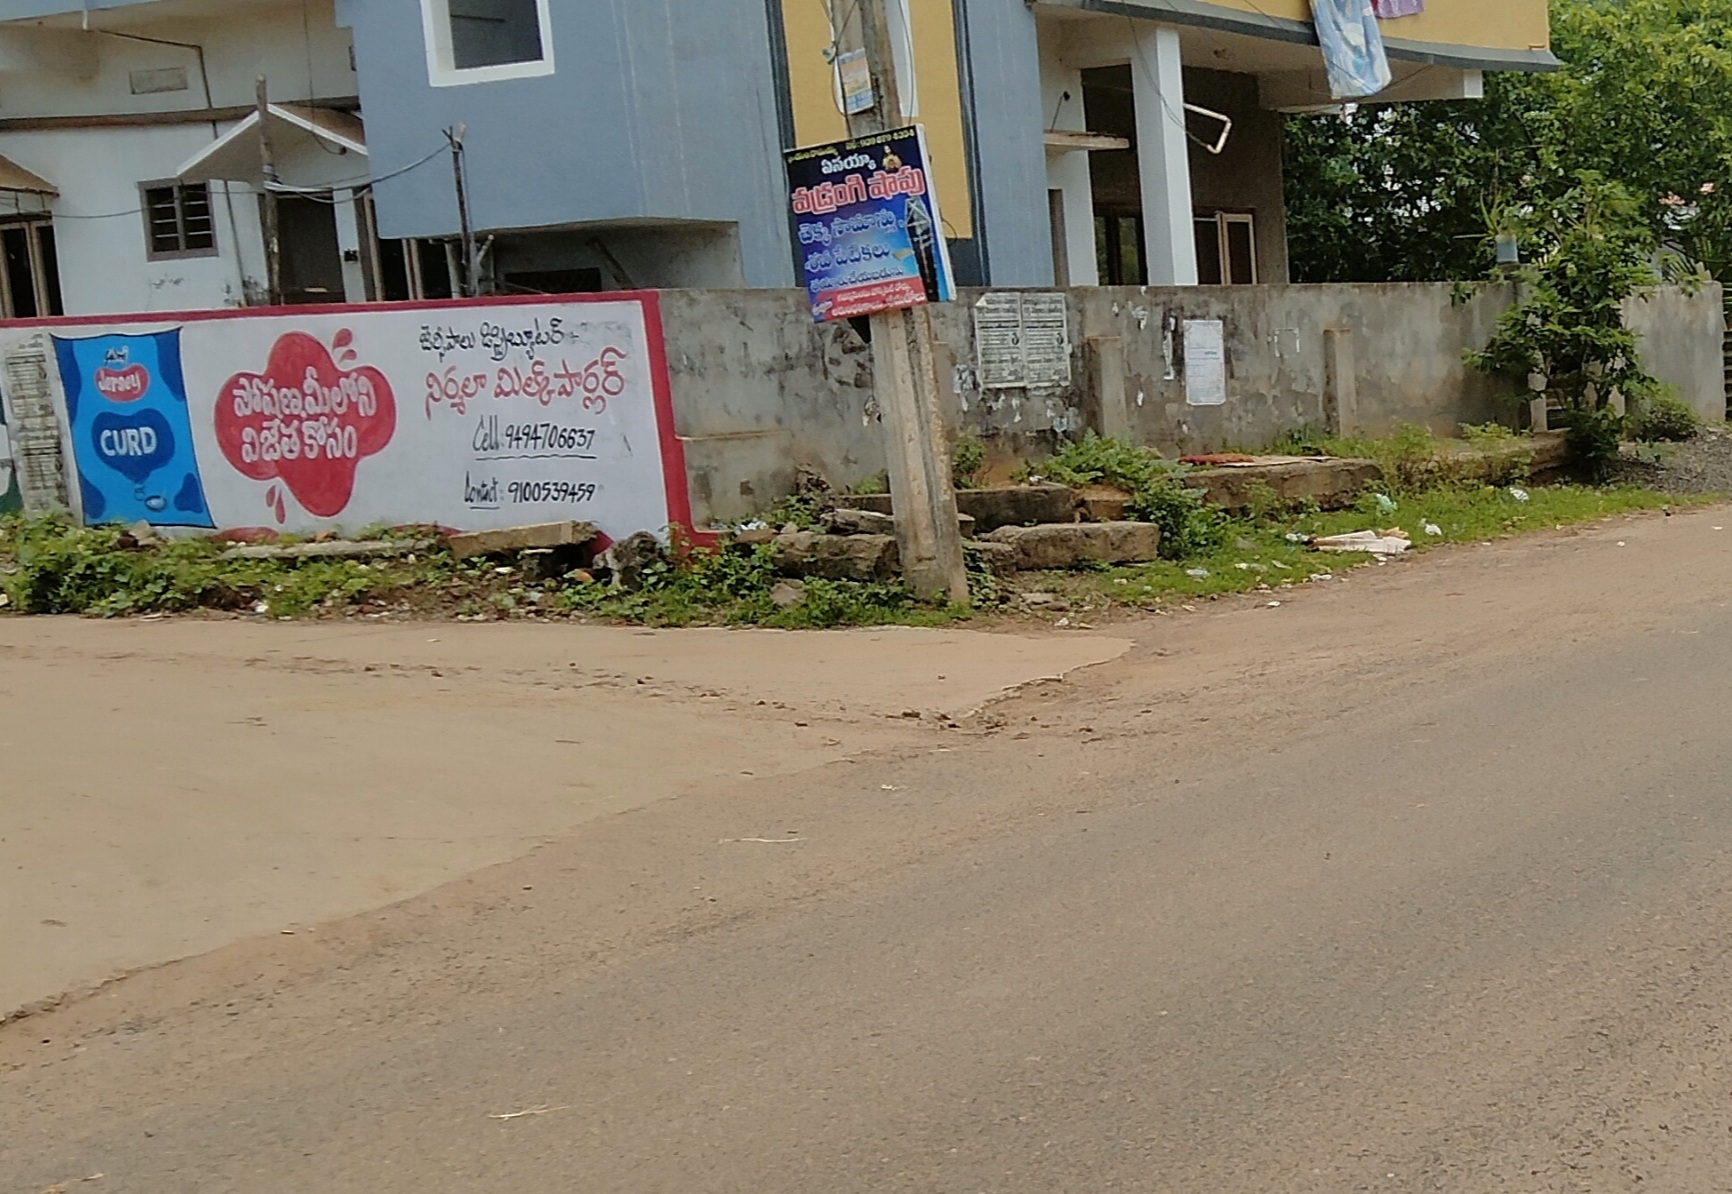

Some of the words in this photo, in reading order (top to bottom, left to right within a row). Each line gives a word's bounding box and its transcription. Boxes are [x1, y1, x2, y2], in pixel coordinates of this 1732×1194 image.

[867, 166, 926, 200] షాపు
[98, 369, 142, 394] Jersey
[101, 426, 158, 457] CURD
[242, 418, 301, 463] విజేత
[302, 416, 358, 460] కోసం
[505, 423, 596, 450] 9494706637
[508, 482, 596, 504] 9100539459
